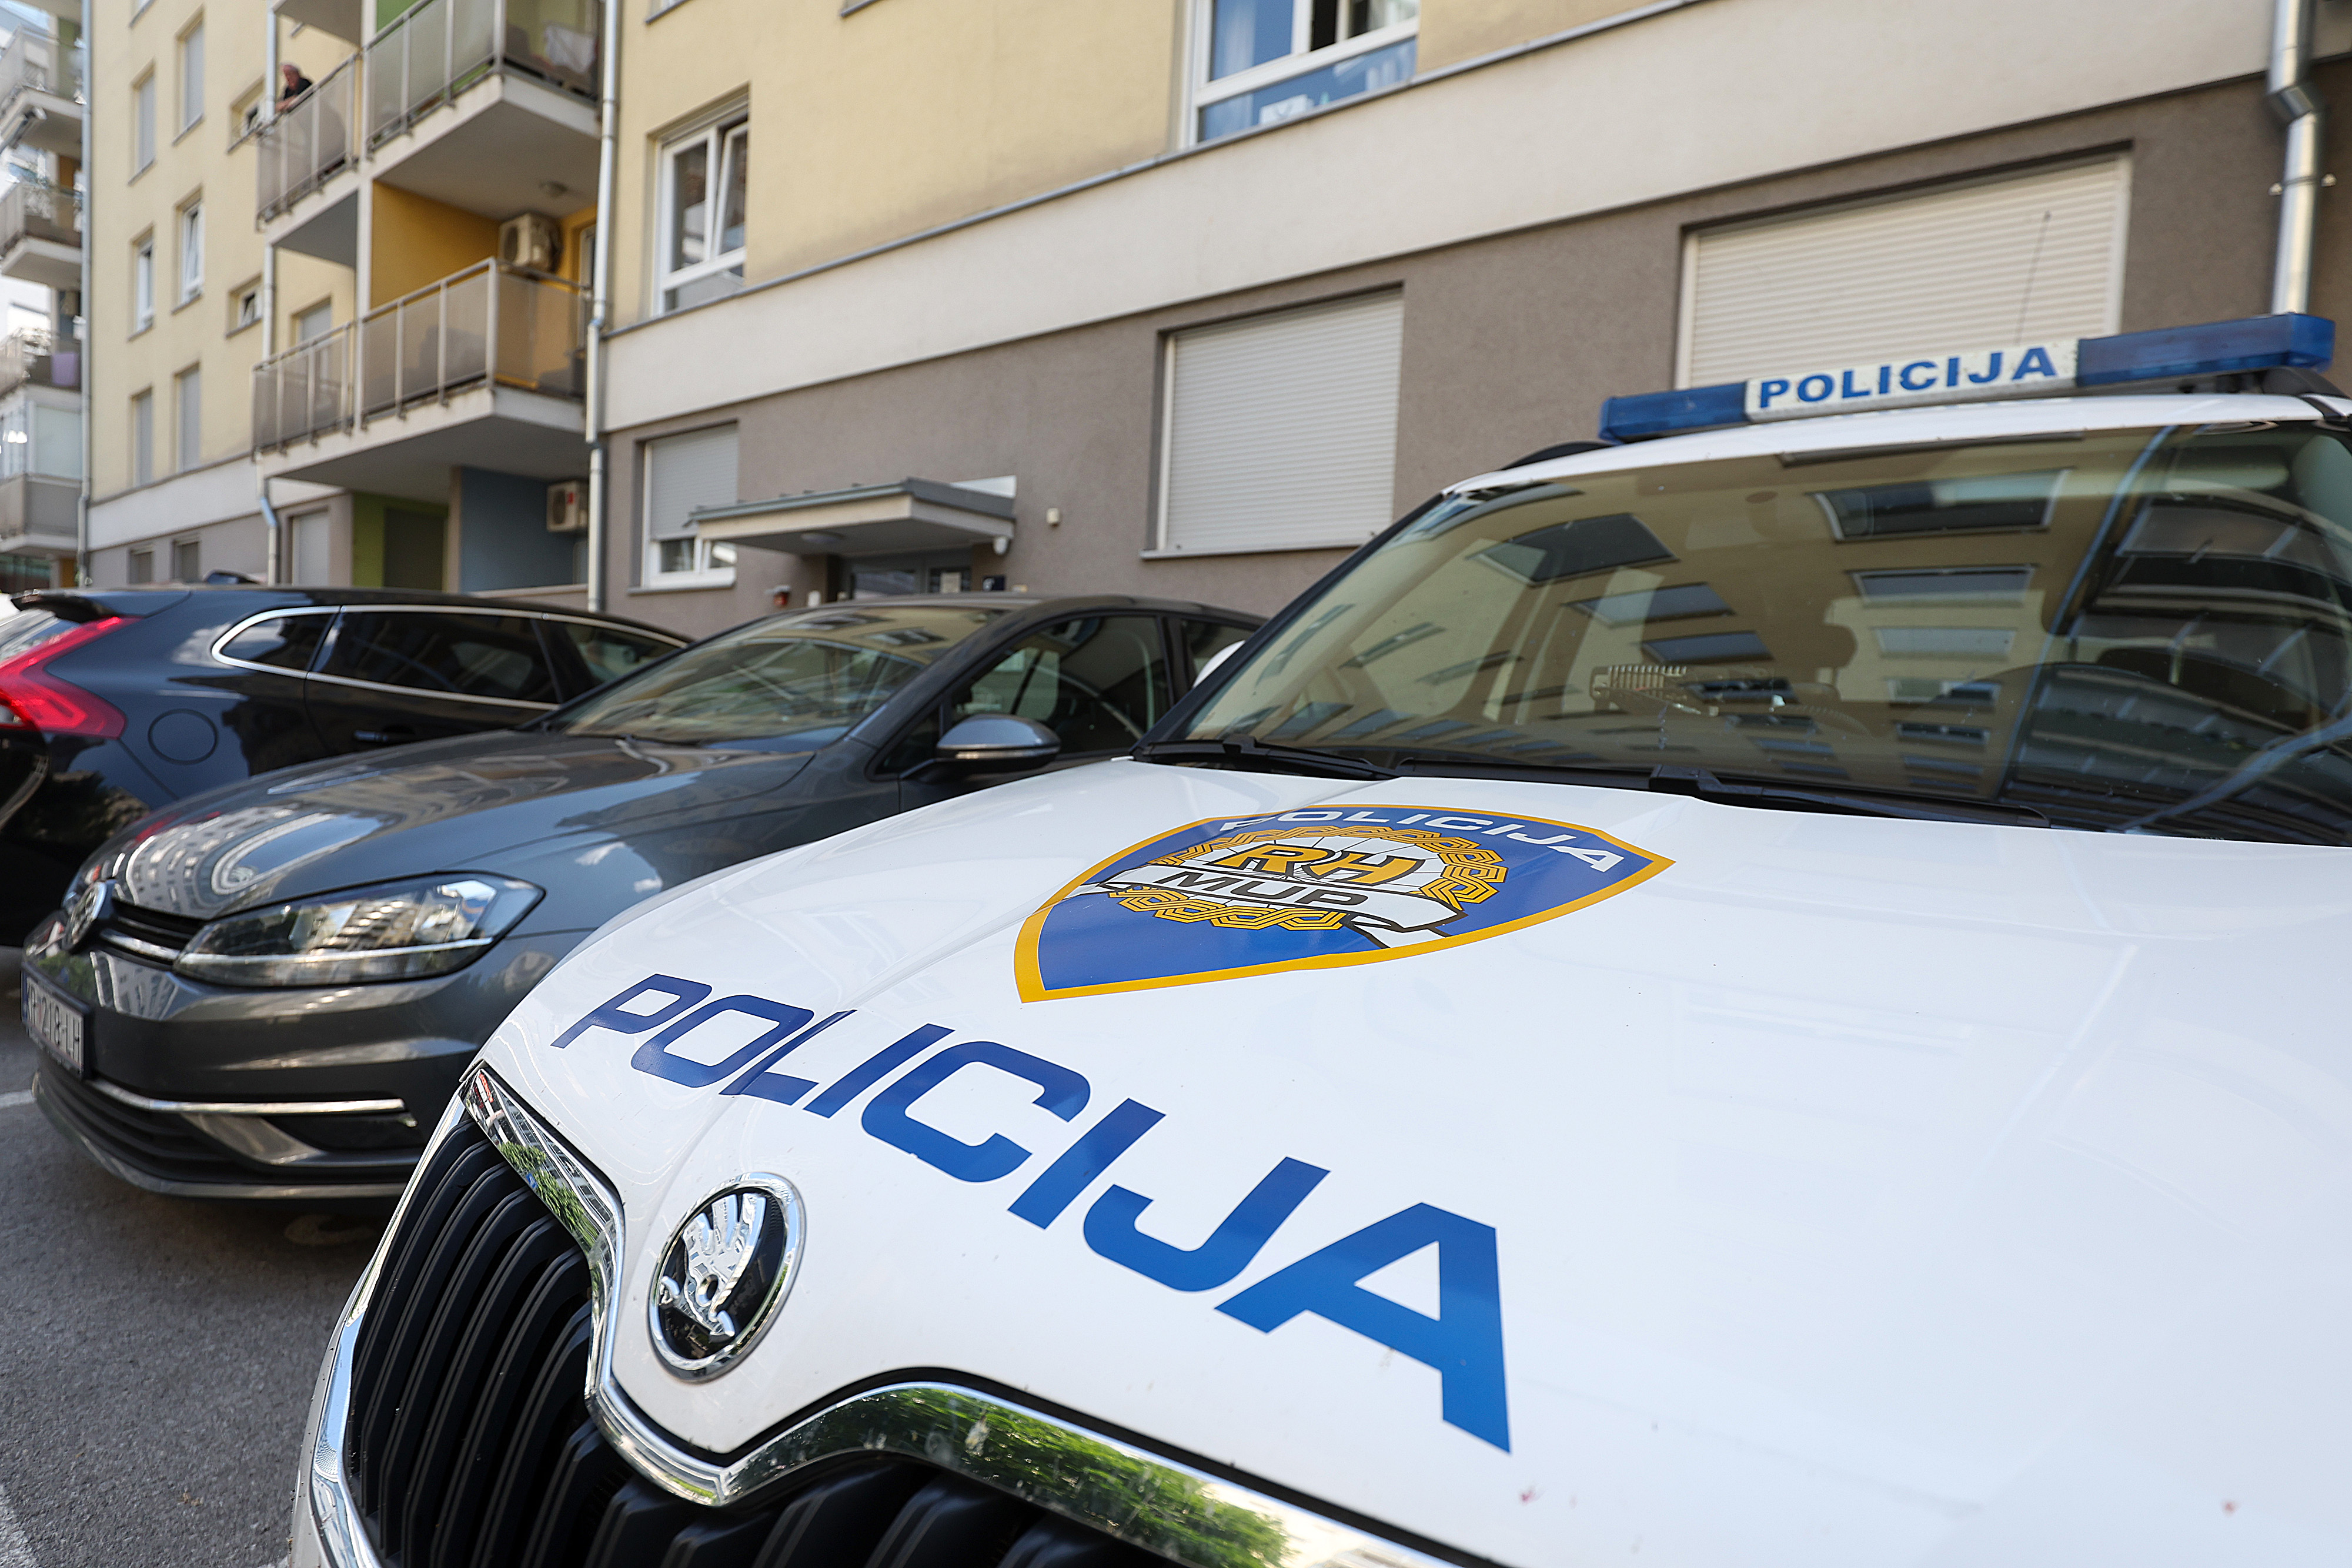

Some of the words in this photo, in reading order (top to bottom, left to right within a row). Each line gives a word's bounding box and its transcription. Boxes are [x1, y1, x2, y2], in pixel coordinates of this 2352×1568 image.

[1760, 346, 2057, 409] POLICIJA
[1202, 843, 1425, 886] RH
[1219, 810, 1625, 872] POLICIJA
[1158, 871, 1369, 906] MUP
[550, 973, 1511, 1453] POLICIJA
